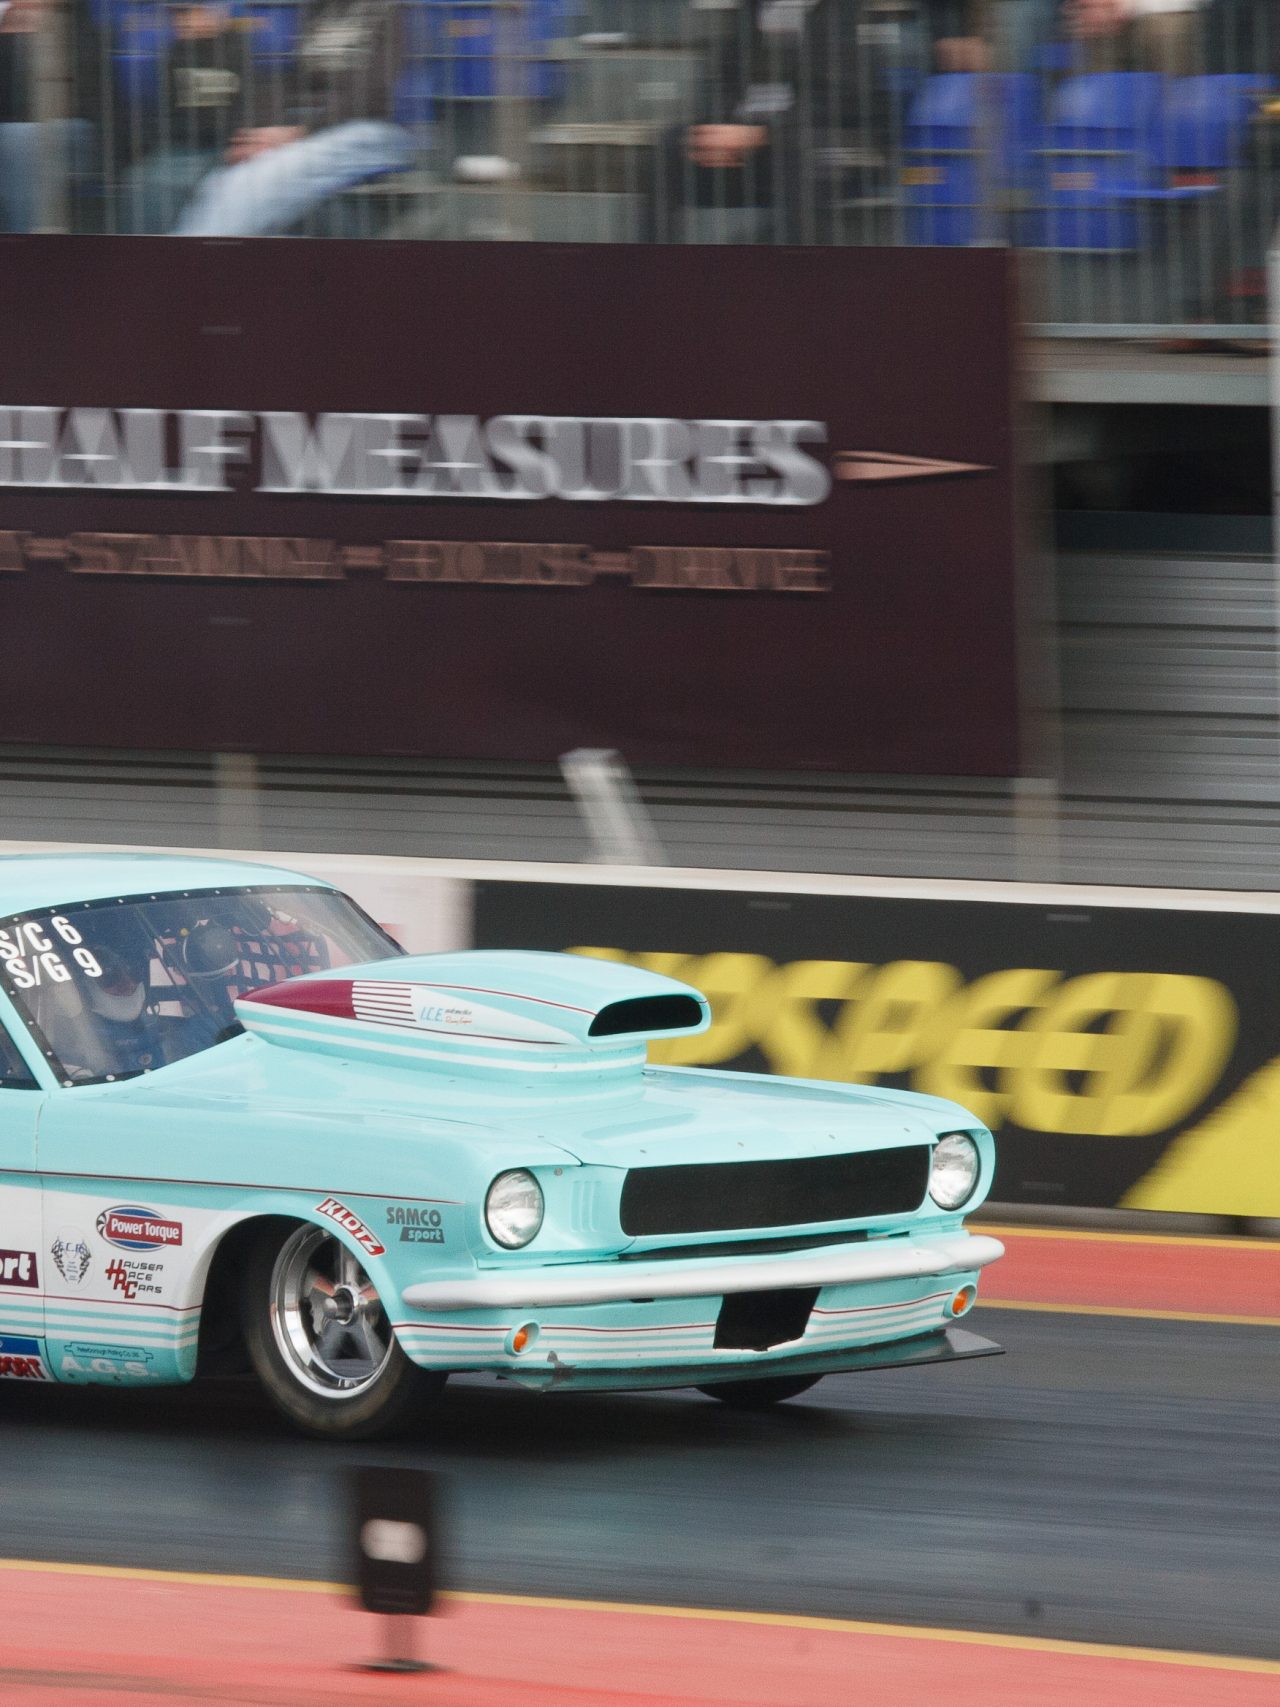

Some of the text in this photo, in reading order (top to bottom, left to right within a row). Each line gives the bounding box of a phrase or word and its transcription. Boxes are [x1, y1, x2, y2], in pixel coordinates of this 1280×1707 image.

[255, 410, 832, 507] MEASURES
[51, 916, 82, 945] 6
[5, 947, 103, 989] S/G 9
[321, 1200, 376, 1253] KLOTZ
[386, 1206, 442, 1227] SAMCO
[111, 1218, 180, 1240] Power Torque
[408, 1229, 441, 1241] sport
[105, 1259, 164, 1280] HAUSER
[113, 1270, 153, 1290] RACE
[124, 1281, 163, 1299] CARS
